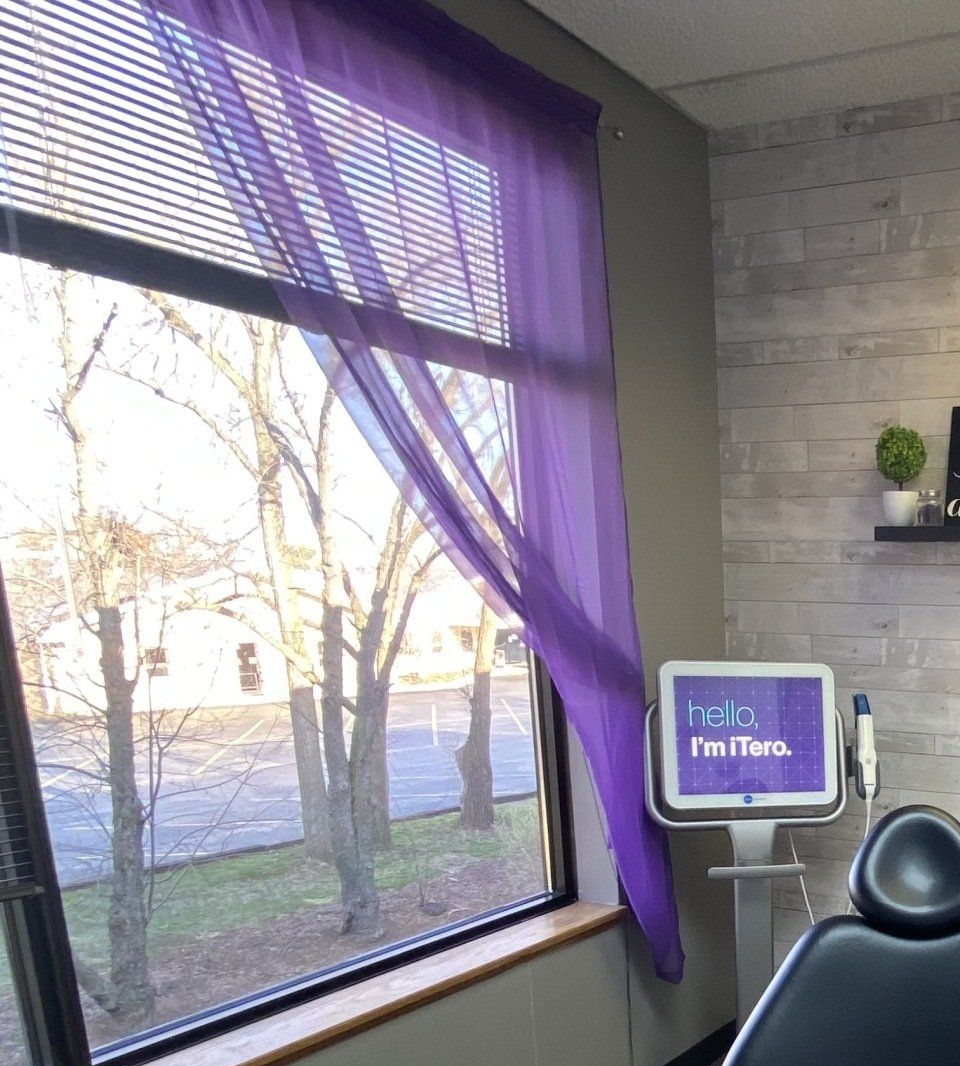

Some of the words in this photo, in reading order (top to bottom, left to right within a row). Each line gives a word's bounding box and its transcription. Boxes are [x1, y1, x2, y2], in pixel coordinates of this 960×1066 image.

[688, 699, 759, 730] hello,
[691, 737, 726, 757] I'm
[730, 736, 792, 757] iTero.
